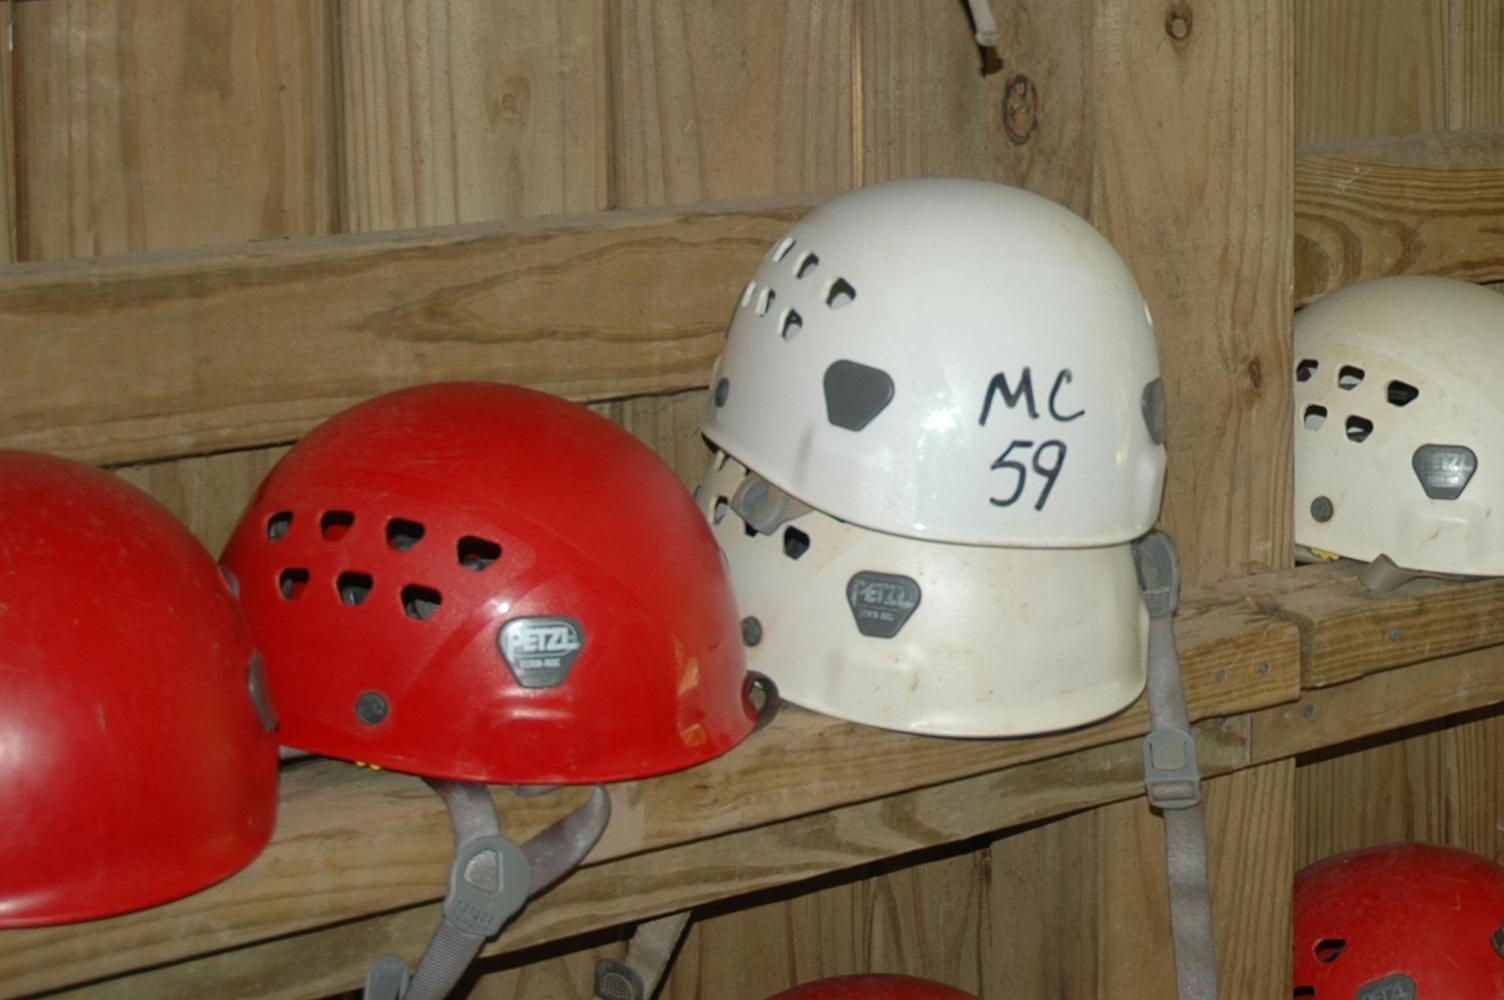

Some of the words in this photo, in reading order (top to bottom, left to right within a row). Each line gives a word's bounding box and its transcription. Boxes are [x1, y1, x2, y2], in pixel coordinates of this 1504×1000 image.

[978, 366, 1085, 426] MC
[989, 440, 1067, 512] 59
[507, 626, 581, 665] PETZL
